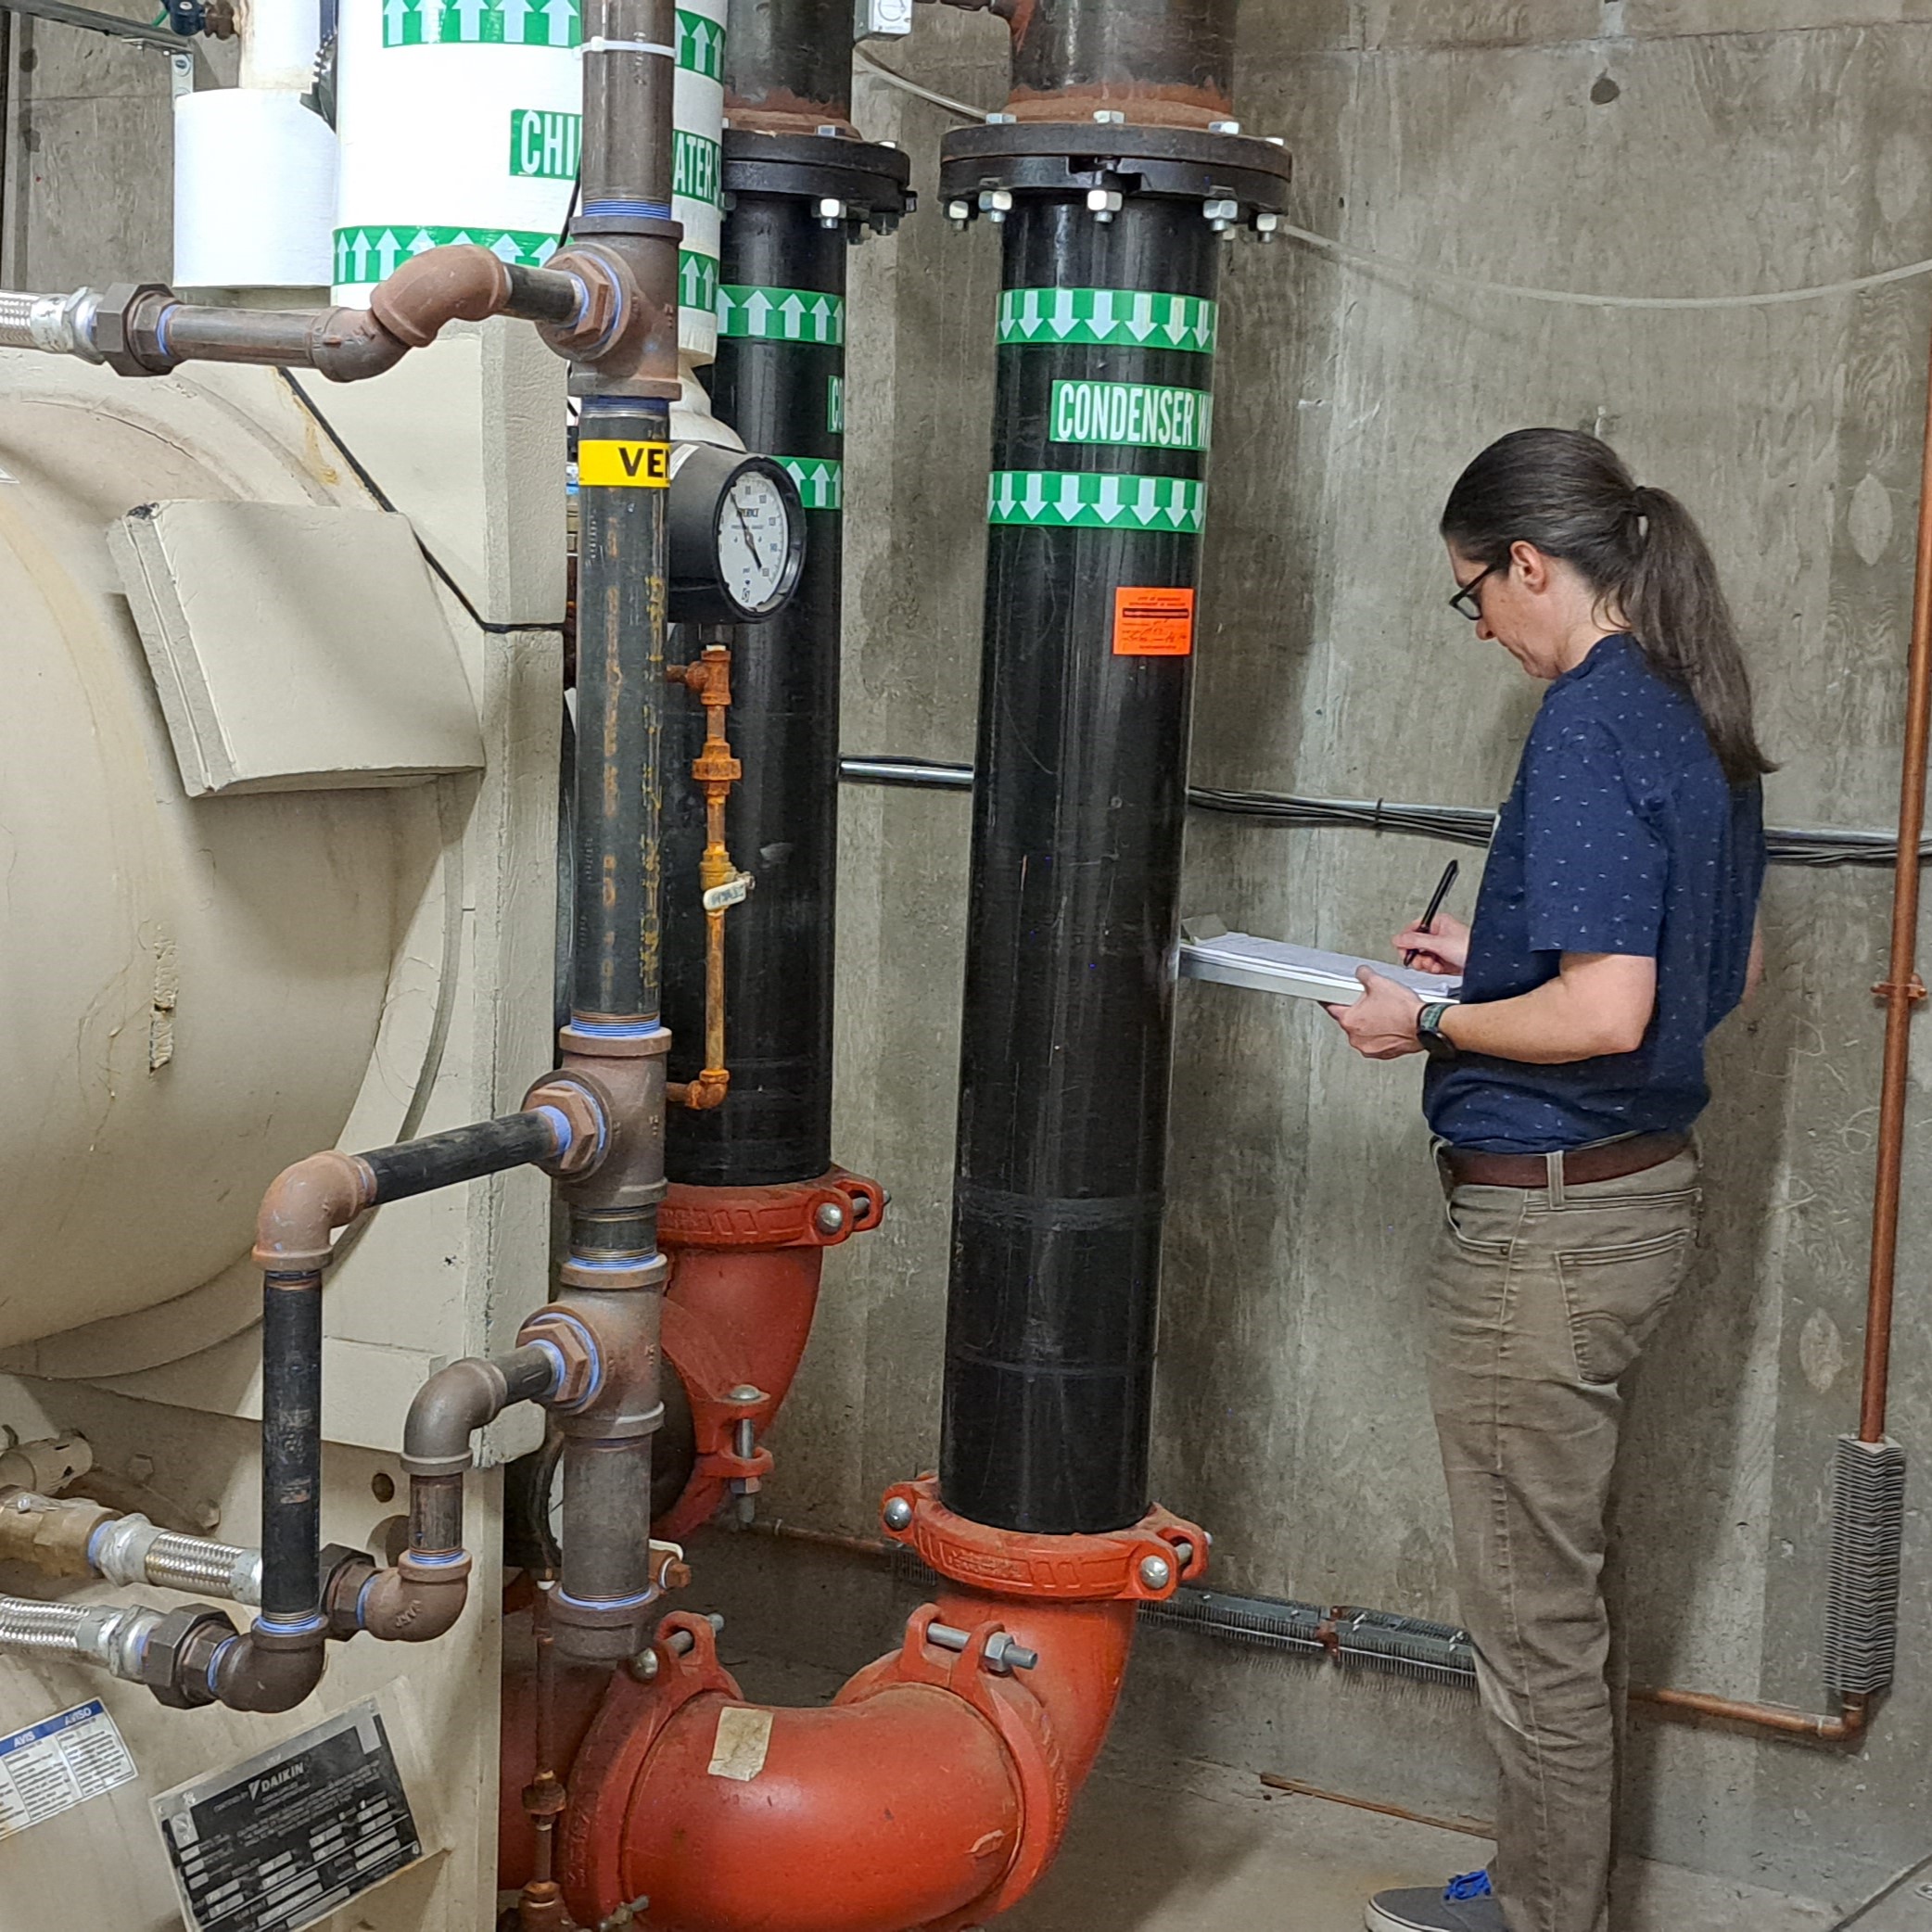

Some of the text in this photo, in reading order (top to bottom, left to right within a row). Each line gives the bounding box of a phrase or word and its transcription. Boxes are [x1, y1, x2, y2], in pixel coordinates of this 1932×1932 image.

[521, 109, 582, 176] CHI
[673, 131, 713, 199] ATER
[1058, 383, 1194, 446] CONDENSER
[618, 447, 670, 478] VE
[64, 1707, 92, 1726] AVISO
[13, 1731, 36, 1748] AVIS
[261, 1762, 304, 1792] DAIKIN
